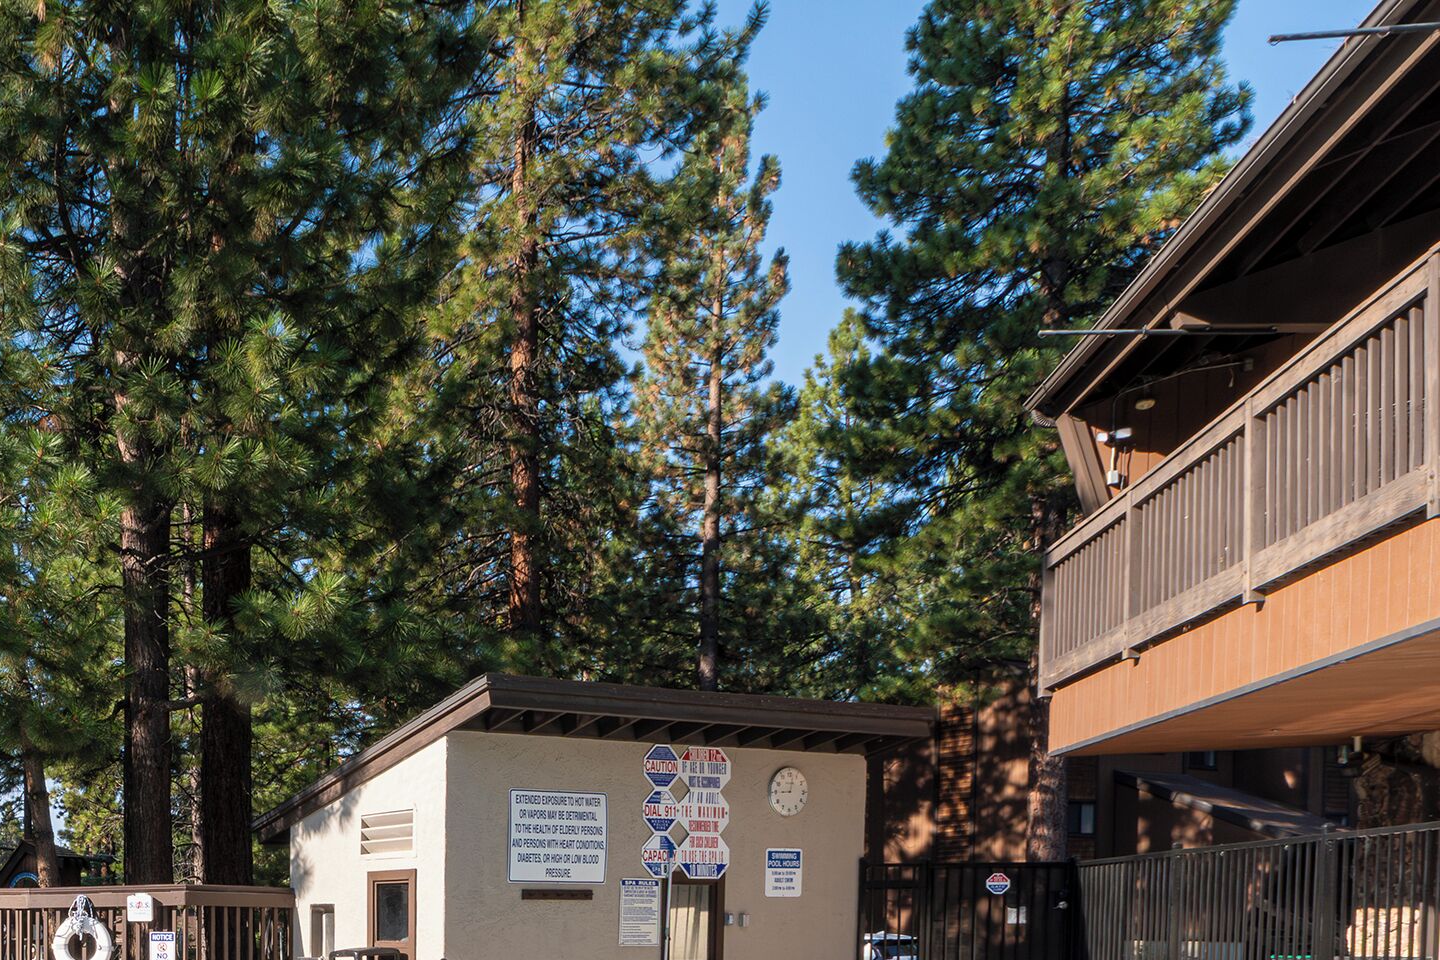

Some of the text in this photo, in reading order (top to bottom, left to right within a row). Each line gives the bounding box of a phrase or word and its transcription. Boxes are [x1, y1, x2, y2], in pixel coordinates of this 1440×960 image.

[645, 760, 678, 772] CAUTION
[700, 762, 704, 774] OR
[708, 762, 726, 774] YOUNGER
[516, 794, 600, 807] EXTENDED EXPOSURE TO HOT WATER
[706, 792, 720, 804] ADULT
[520, 809, 597, 821] OR VAPORS MAY BE DETRIMENTAL
[644, 805, 676, 817] DIAL 911
[682, 806, 725, 818] THE MAXIMUM
[515, 824, 603, 835] TO THE HEALTH OF ELDERLY PERSONS
[512, 839, 522, 848] AND
[523, 839, 546, 848] PERSONS
[547, 839, 558, 848] WITH
[560, 840, 575, 849] HEART
[518, 853, 599, 864] DIABETES, OR HIGH OR LOW BLOOD
[643, 850, 678, 861] CAPACIY
[682, 850, 687, 862] TO
[699, 850, 707, 862] THE
[546, 868, 572, 878] PRESSURE.
